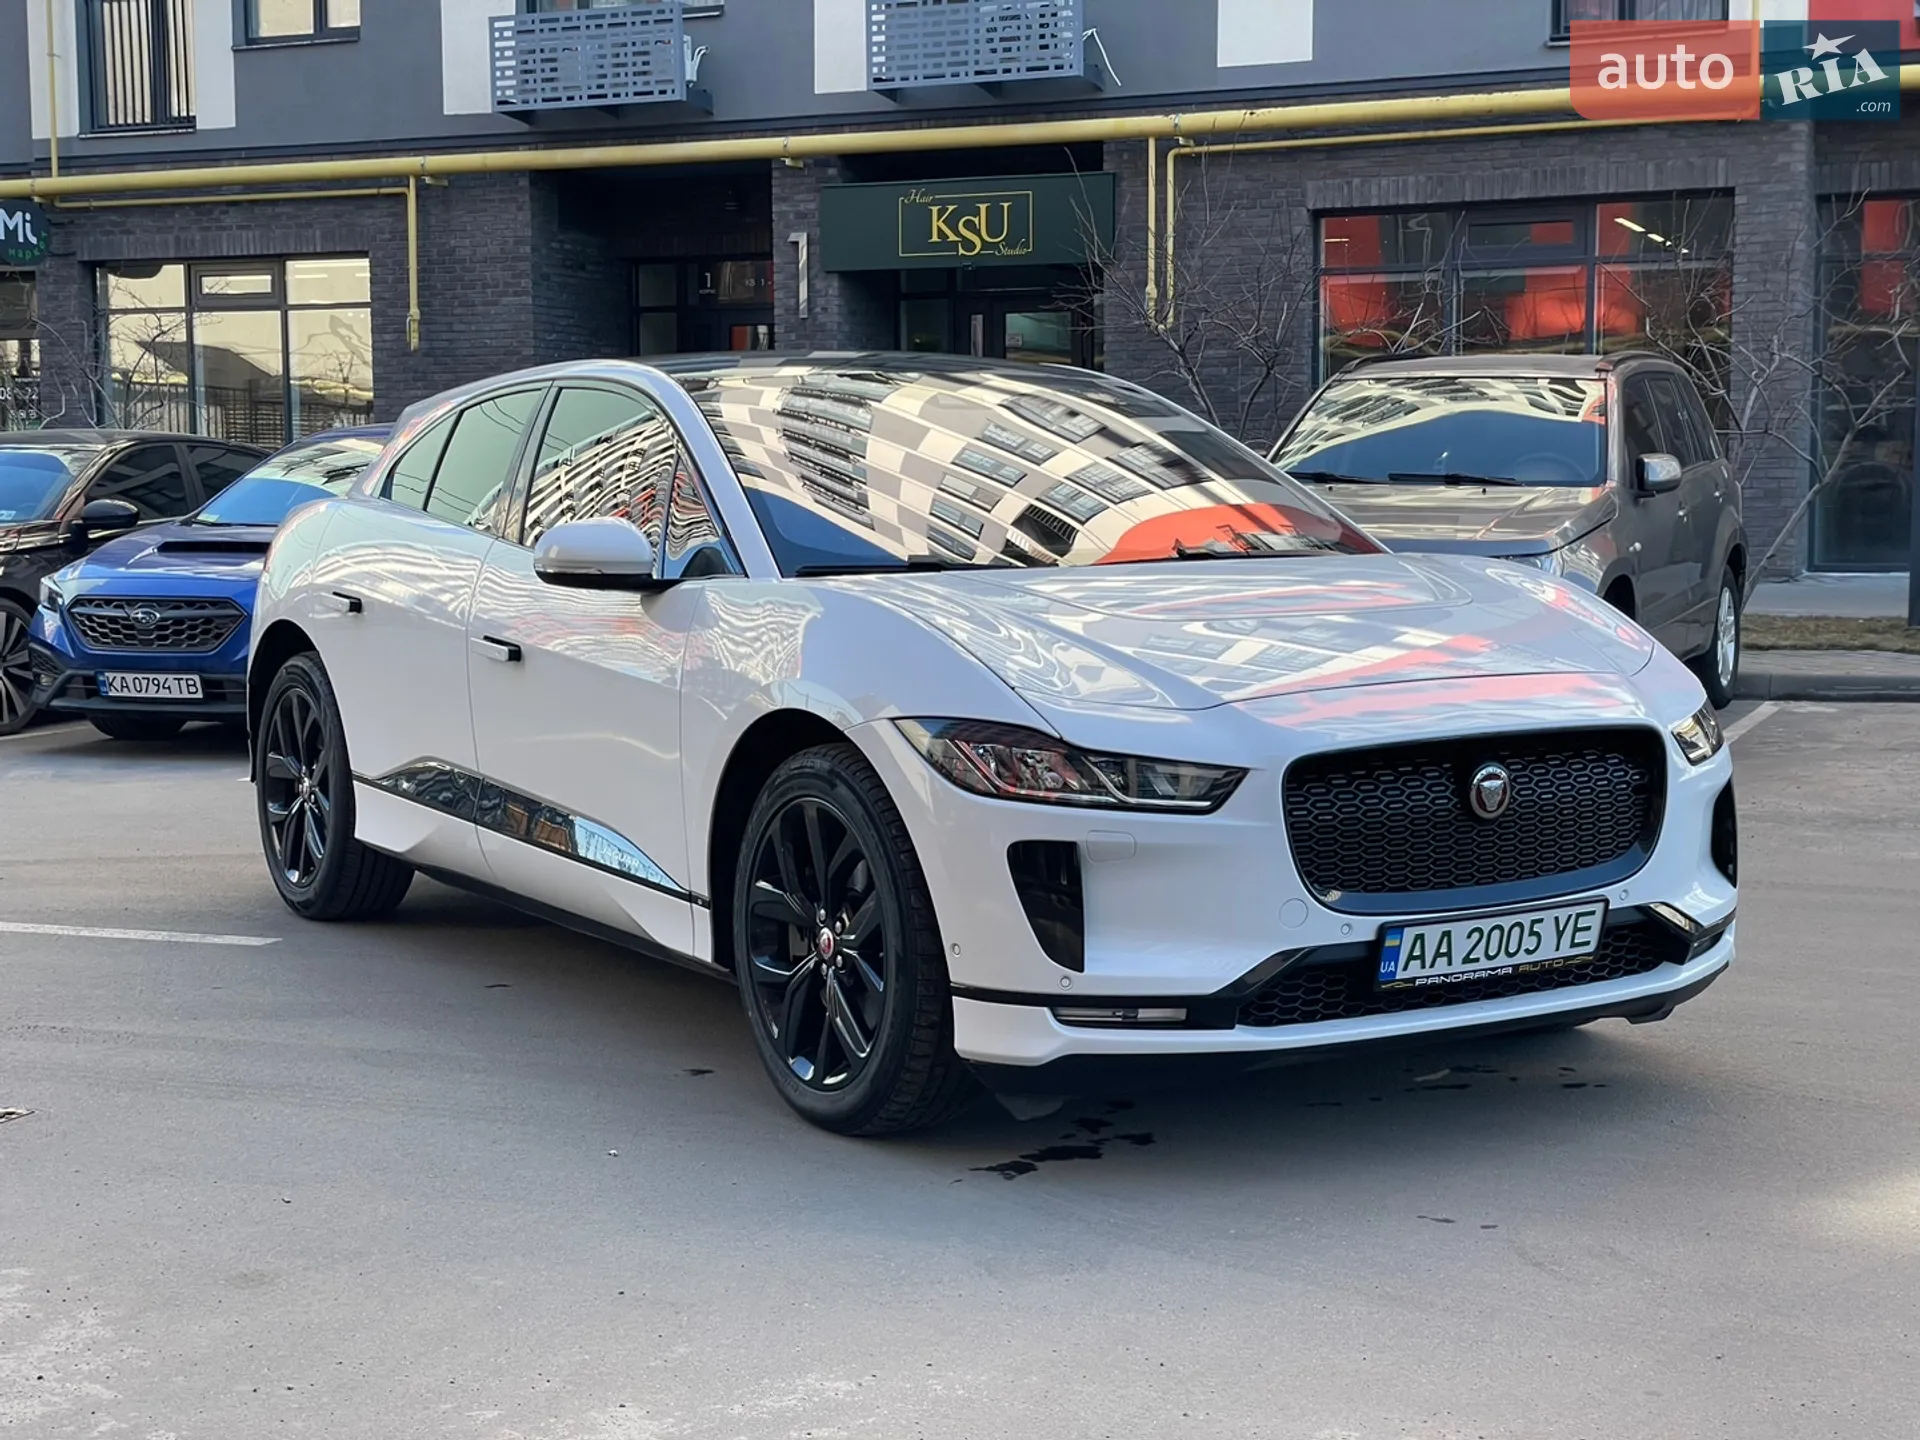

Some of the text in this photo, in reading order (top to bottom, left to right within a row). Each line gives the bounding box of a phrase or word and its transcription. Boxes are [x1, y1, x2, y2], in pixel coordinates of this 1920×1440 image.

[904, 189, 933, 204] Hair
[994, 239, 1028, 256] Studio
[787, 232, 808, 318] 1
[1402, 909, 1597, 972] AA 2005 YE
[1380, 960, 1396, 974] UA
[1414, 957, 1565, 987] PANORAMA AUTO
